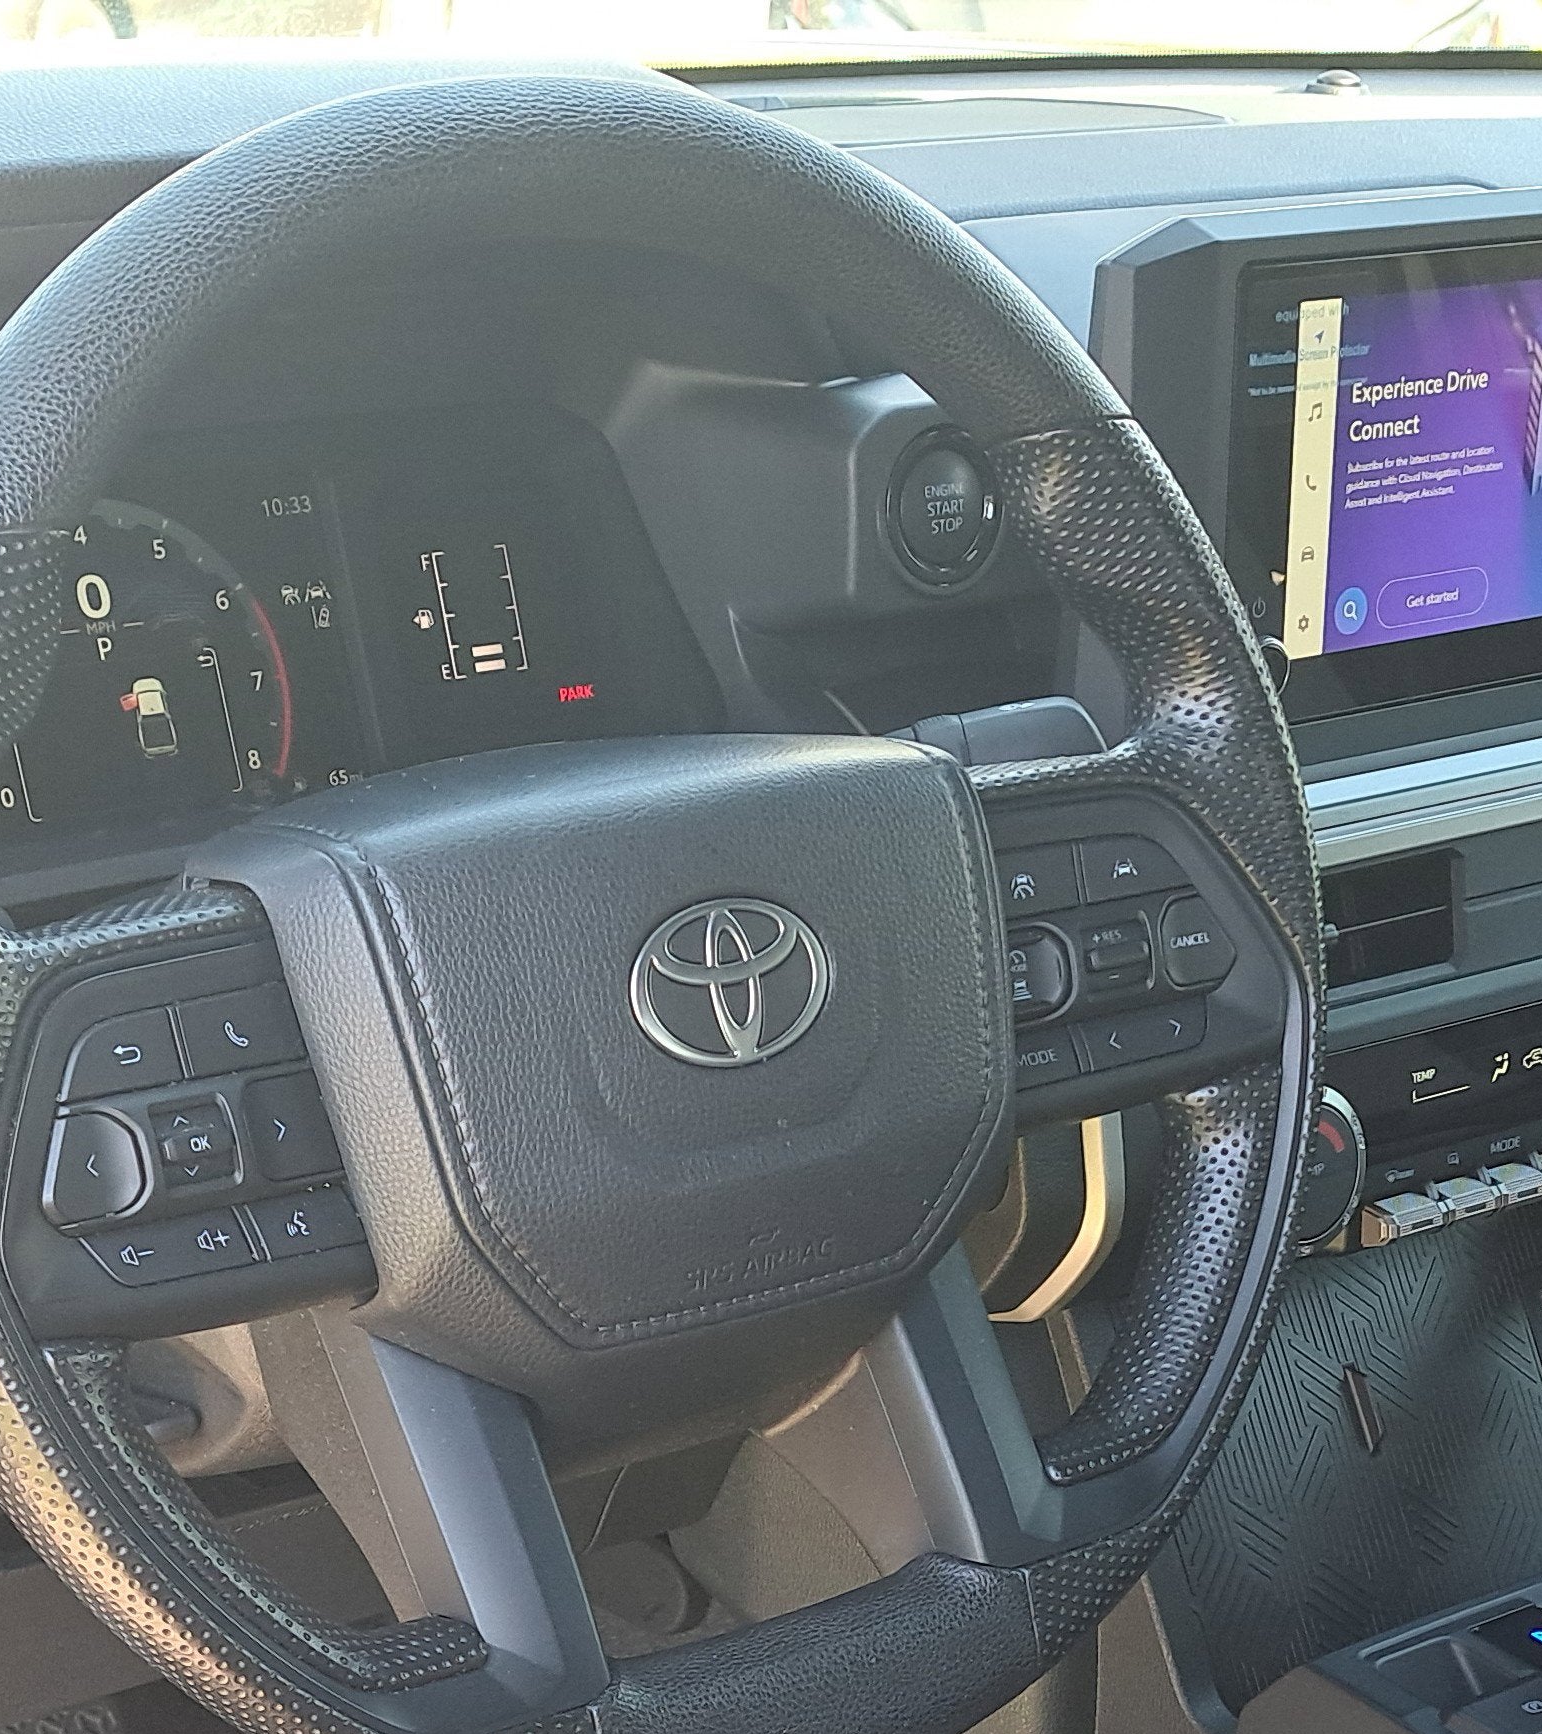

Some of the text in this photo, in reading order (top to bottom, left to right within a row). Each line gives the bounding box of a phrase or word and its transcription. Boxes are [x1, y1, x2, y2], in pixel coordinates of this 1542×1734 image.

[1352, 375, 1443, 407] Experience
[1447, 368, 1489, 391] Drive
[1349, 414, 1420, 441] Connect
[1347, 460, 1383, 474] Subscribe
[1396, 456, 1408, 466] the
[1451, 448, 1465, 459] and
[1467, 446, 1495, 457] location
[1382, 475, 1397, 486] with
[1398, 471, 1420, 483] Cloud
[924, 481, 965, 499] ENGINE
[261, 495, 312, 517] 10:33
[927, 498, 964, 517] START
[1368, 495, 1382, 505] and
[931, 516, 963, 534] STOP
[73, 525, 88, 545] 4
[152, 539, 166, 560] 5
[420, 553, 430, 572] F
[76, 574, 111, 619] 0
[215, 589, 230, 611] 6
[86, 621, 117, 635] MPH
[97, 637, 112, 661] P
[250, 670, 263, 691] 7
[441, 663, 452, 680] E
[558, 684, 595, 702] PARK
[247, 749, 261, 770] 8
[0, 787, 15, 808] 0
[1169, 932, 1210, 949] CANCEL
[1016, 1049, 1059, 1067] MODE
[1411, 1068, 1436, 1084] TEMP
[190, 1135, 212, 1153] OK
[1490, 1135, 1521, 1154] MODE
